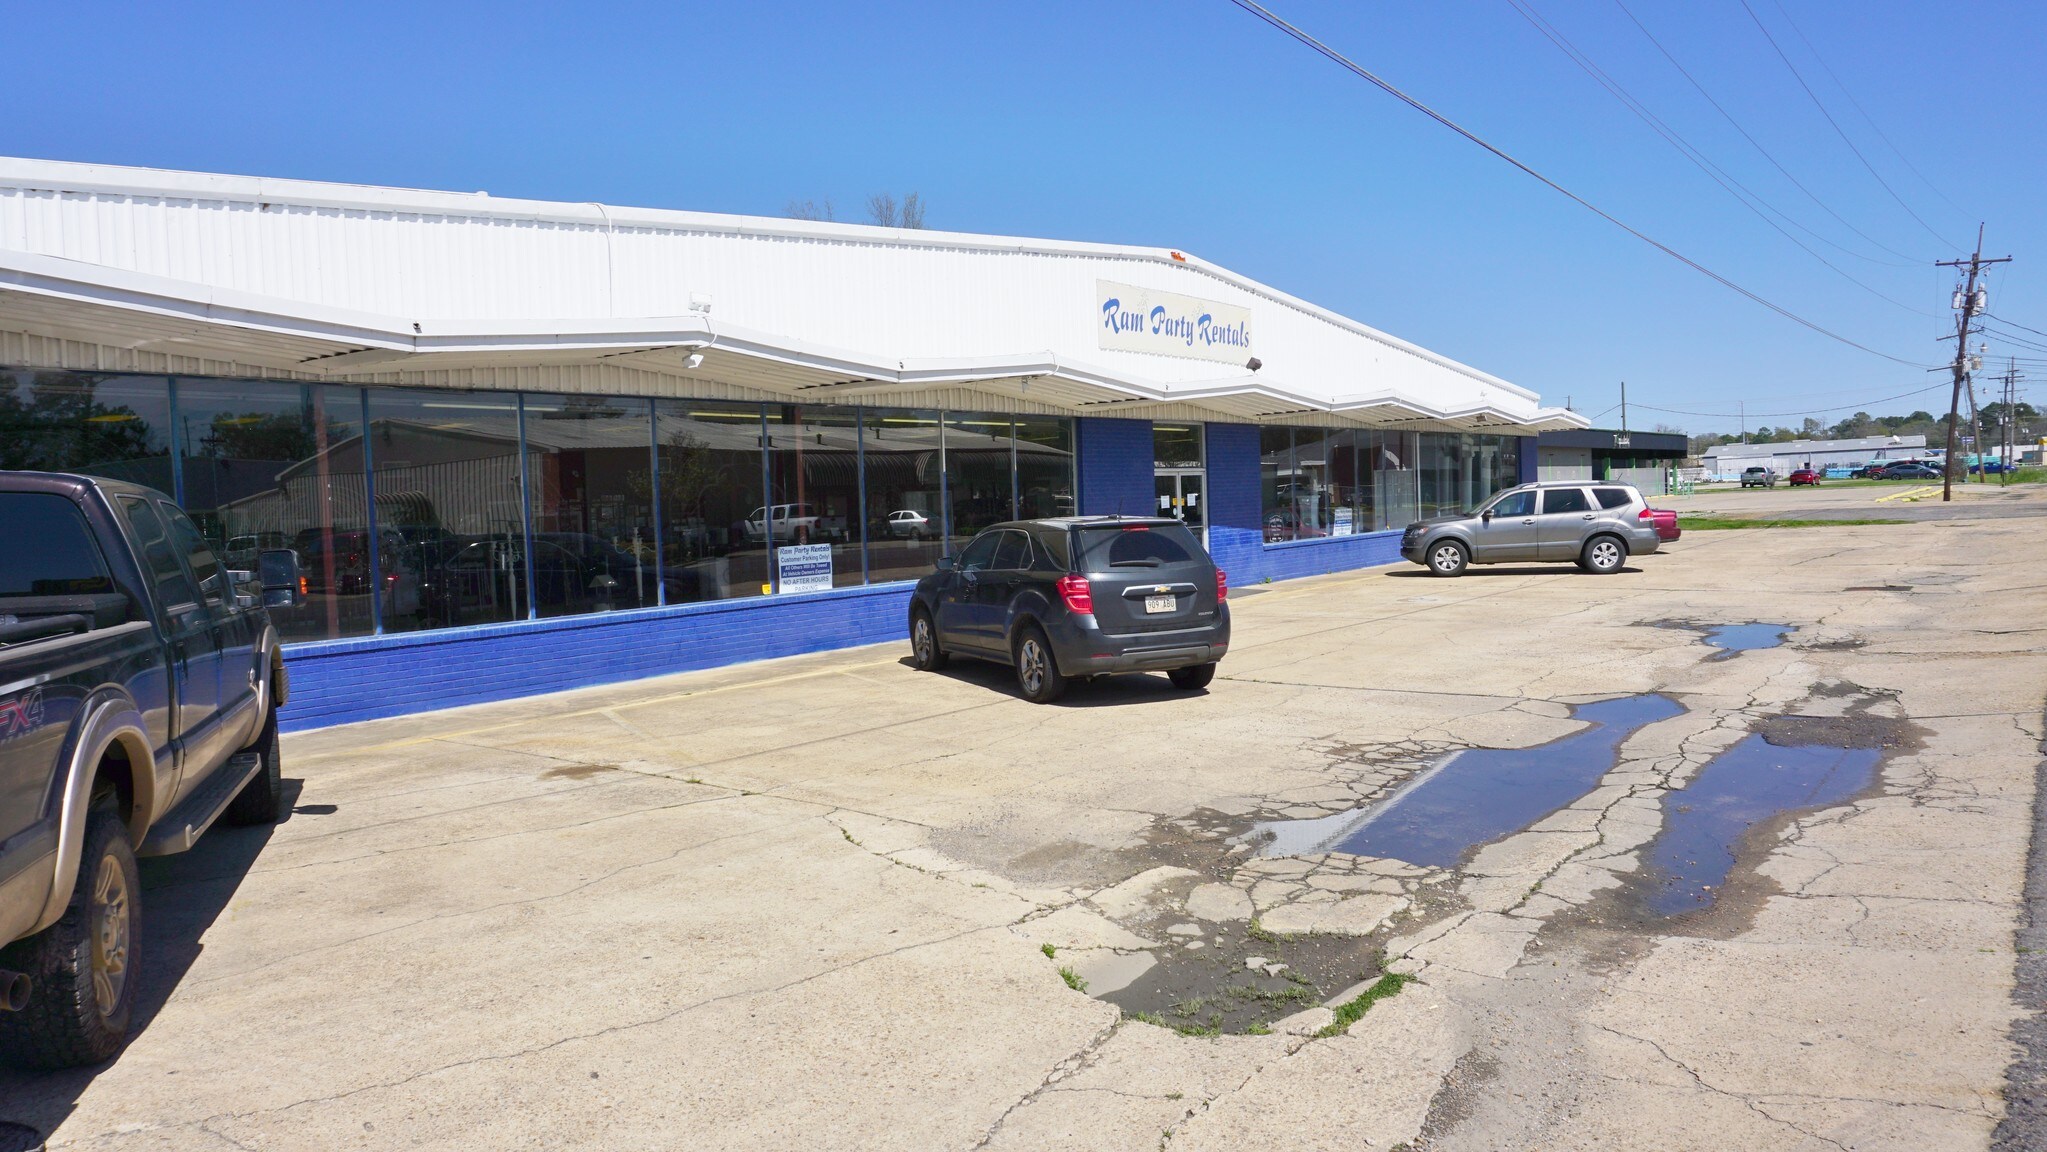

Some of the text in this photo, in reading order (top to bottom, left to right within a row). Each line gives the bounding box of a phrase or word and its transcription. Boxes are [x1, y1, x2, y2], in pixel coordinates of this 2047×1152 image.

[1102, 297, 1250, 348] Ram Party Rentals
[1147, 600, 1159, 608] 909
